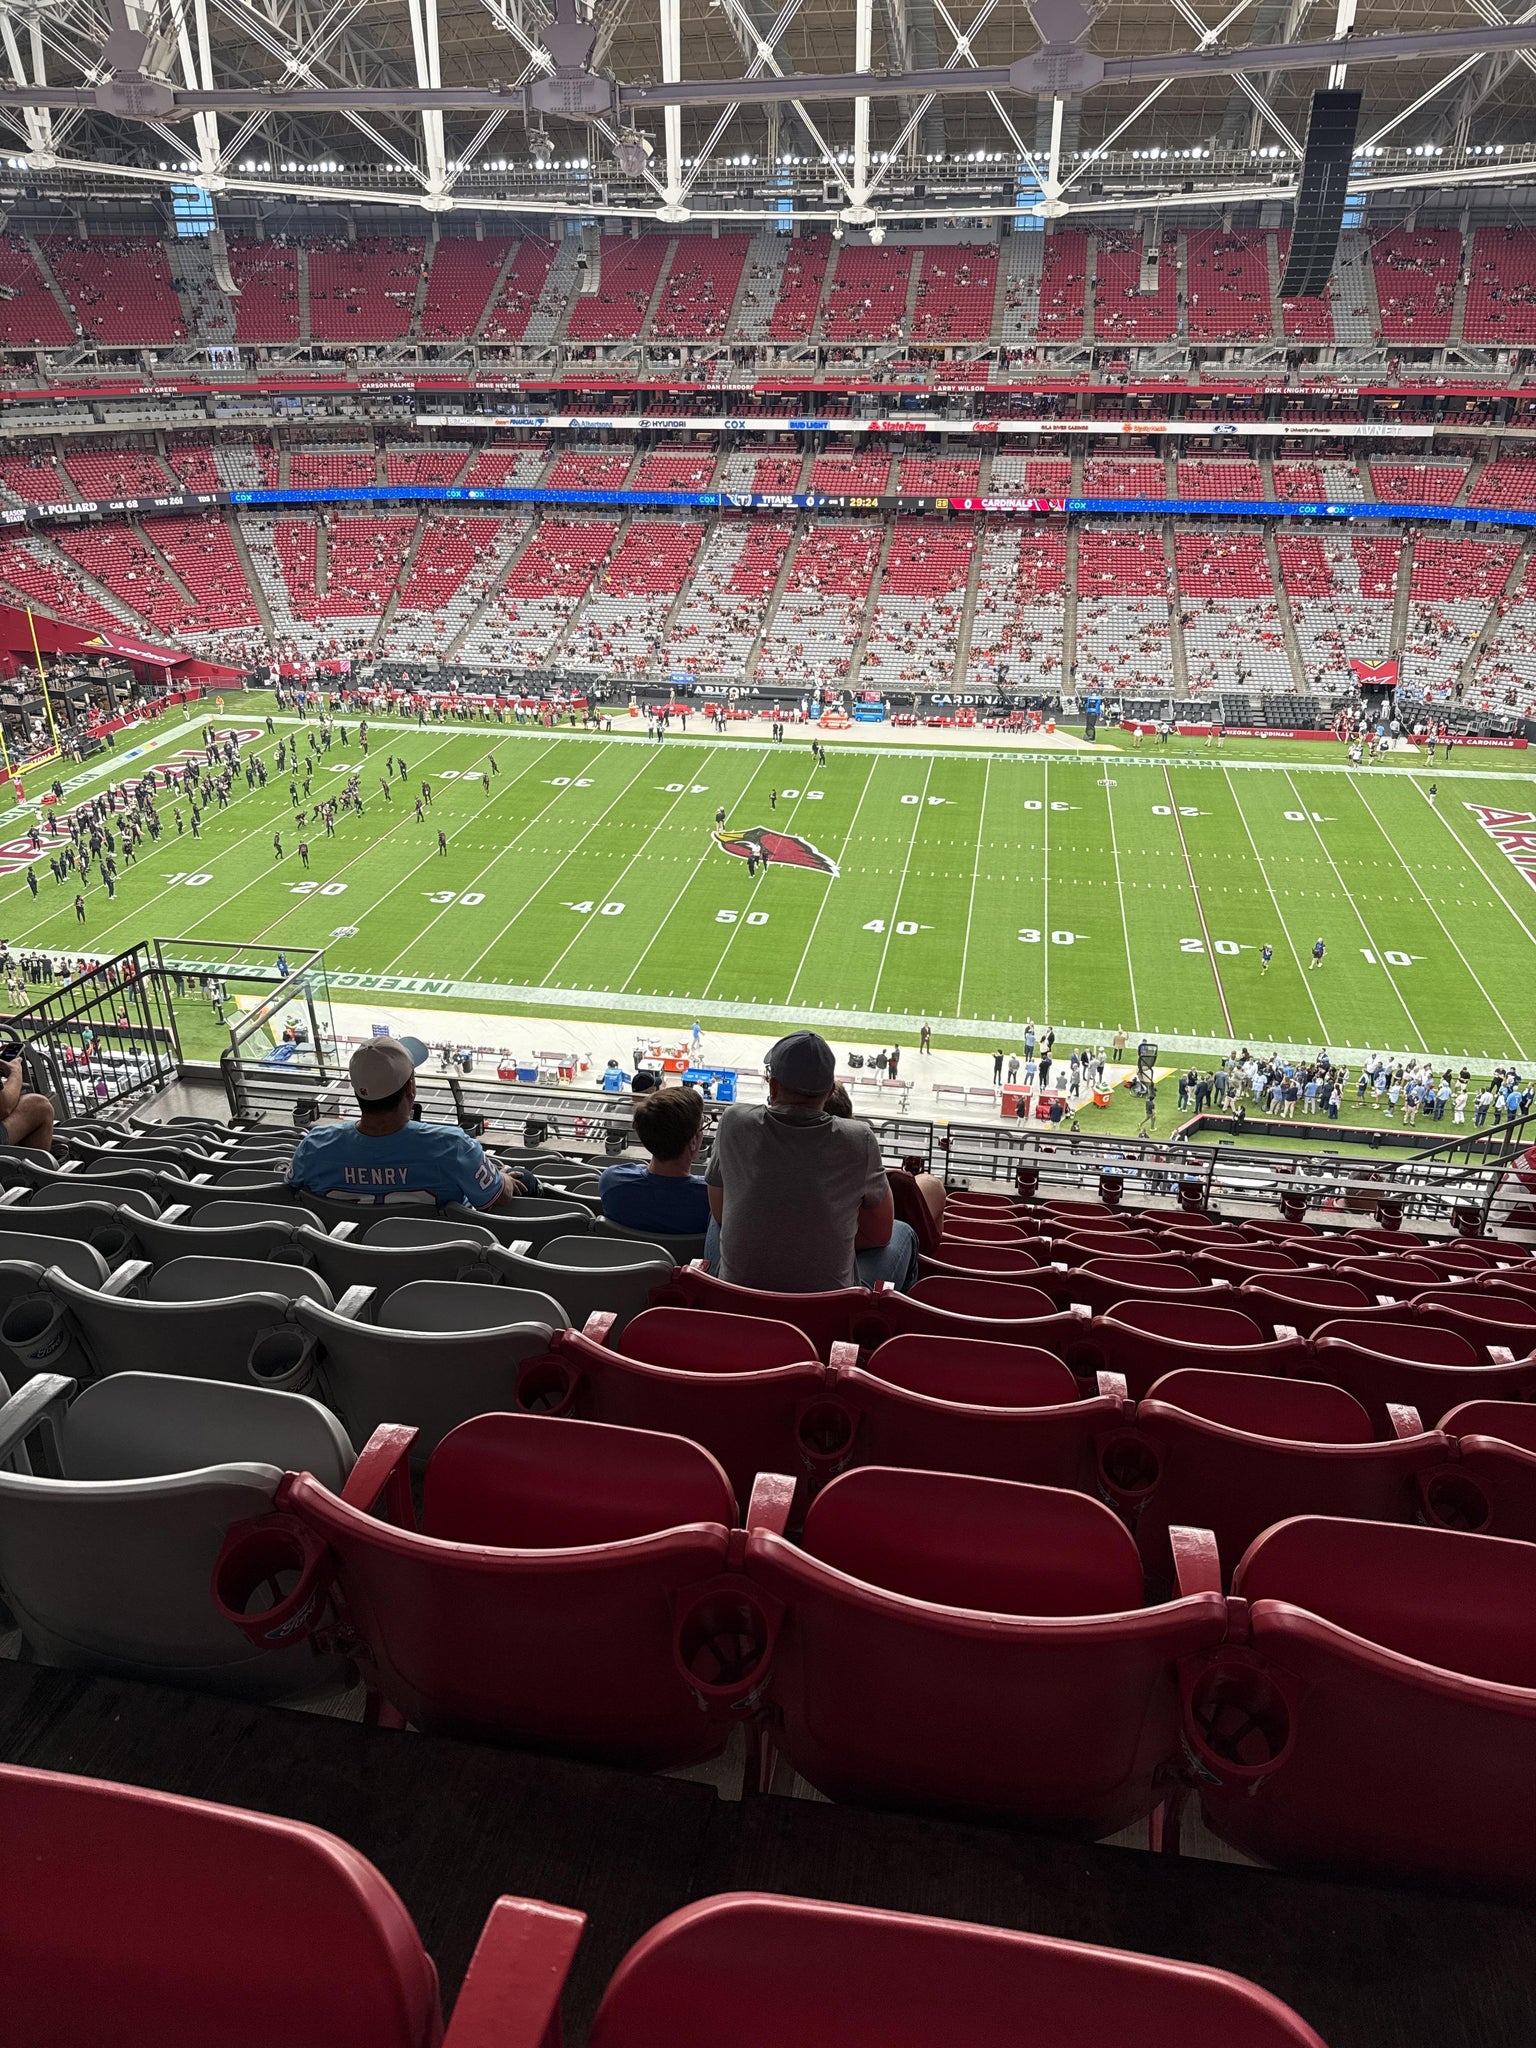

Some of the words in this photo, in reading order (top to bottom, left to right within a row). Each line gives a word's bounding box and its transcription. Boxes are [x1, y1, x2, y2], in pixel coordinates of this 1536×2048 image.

[724, 420, 746, 429] COX
[789, 421, 806, 430] BUD
[806, 421, 829, 430] LIGHT
[881, 421, 904, 431] State
[904, 421, 927, 431] Farm
[1353, 425, 1403, 436] AVNET
[235, 494, 253, 502] COX
[761, 495, 793, 504] TITANS
[805, 496, 815, 507] 0
[849, 497, 879, 507] 29:24
[964, 499, 972, 509] 0
[981, 499, 1033, 507] CARDINALS
[48, 502, 98, 516] POLLARD
[126, 500, 139, 509] 68
[1298, 505, 1318, 513] COX
[1, 508, 27, 518] SEASON
[118, 646, 177, 664] verizon
[551, 777, 596, 788] 30
[664, 783, 711, 794] 40
[781, 789, 825, 800] 50
[900, 794, 946, 806] 40
[1023, 800, 1071, 811] 30
[1151, 805, 1200, 817] 20
[1283, 811, 1325, 823] 10
[288, 881, 349, 896] 20
[429, 891, 486, 906] 30
[570, 901, 626, 916] 40
[715, 910, 770, 926] 50
[862, 919, 920, 936] 40
[1017, 928, 1075, 946] 30
[1179, 938, 1241, 956] 20
[1359, 948, 1413, 966] 10
[343, 1166, 409, 1187] HENRY
